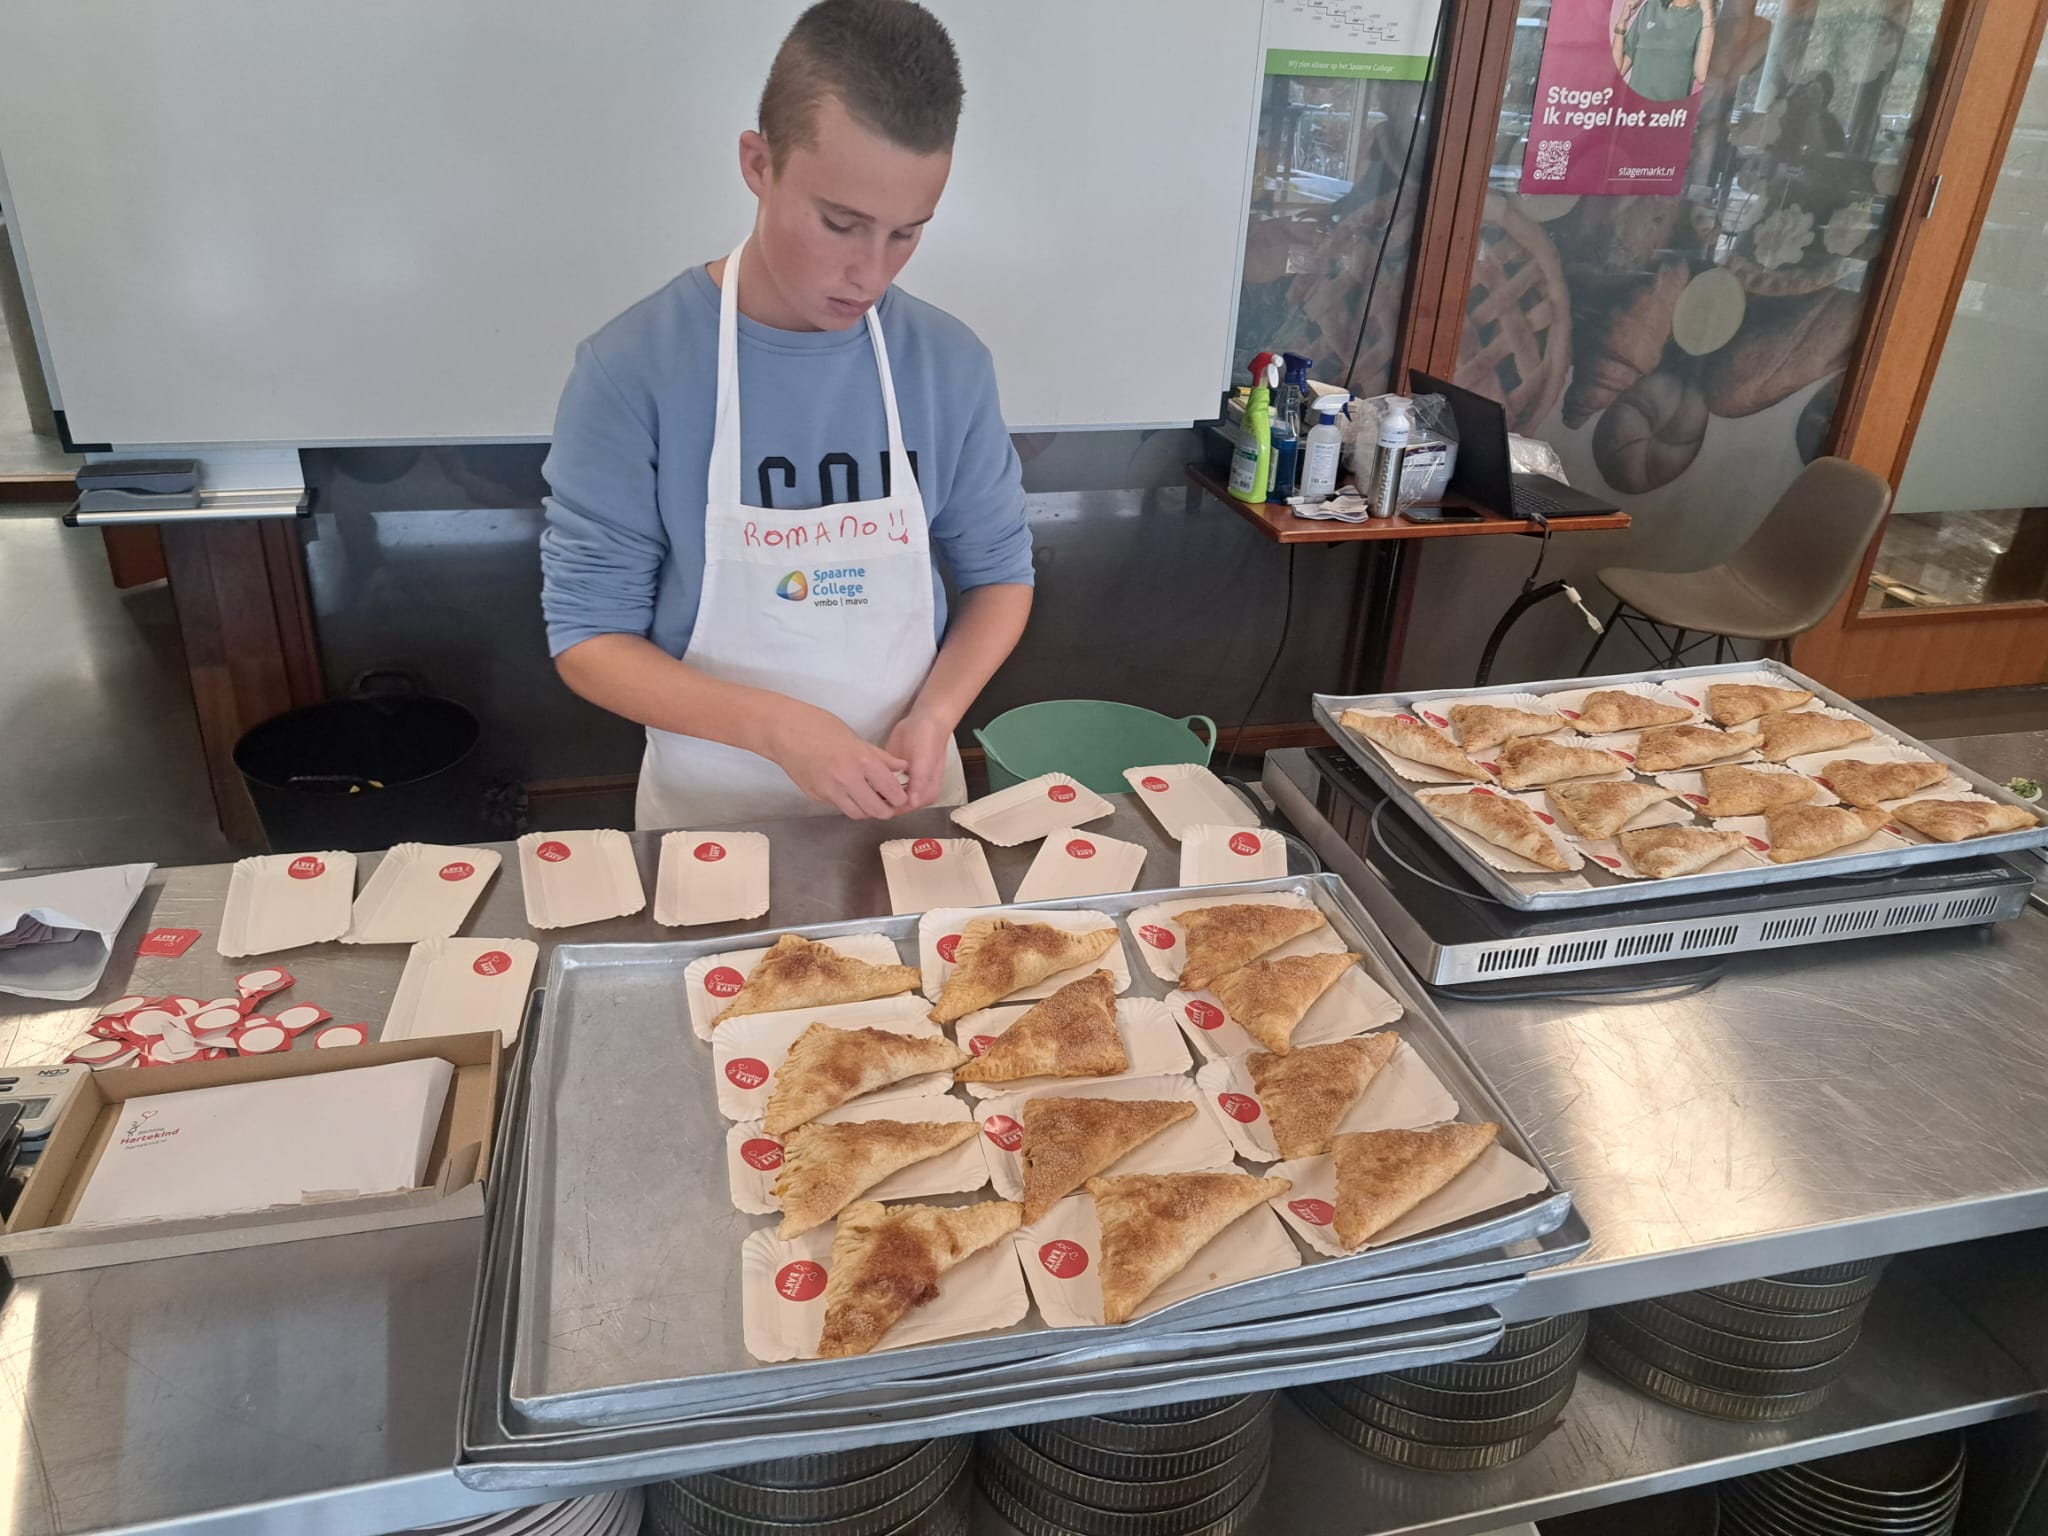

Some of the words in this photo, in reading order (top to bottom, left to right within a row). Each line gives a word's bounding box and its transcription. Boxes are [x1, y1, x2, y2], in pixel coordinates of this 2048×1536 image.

[1372, 64, 1394, 73] College
[1547, 86, 1614, 108] Stage?
[1543, 107, 1560, 125] Ik
[1564, 108, 1613, 130] regel
[1615, 107, 1647, 127] het
[1648, 109, 1688, 128] zelf!
[1618, 166, 1675, 178] stagemarkt.nl
[813, 568, 866, 583] Spaarne
[812, 583, 864, 597] College
[814, 598, 839, 607] vmbo
[845, 598, 869, 606] mavo
[120, 1128, 180, 1145] Hartekind
